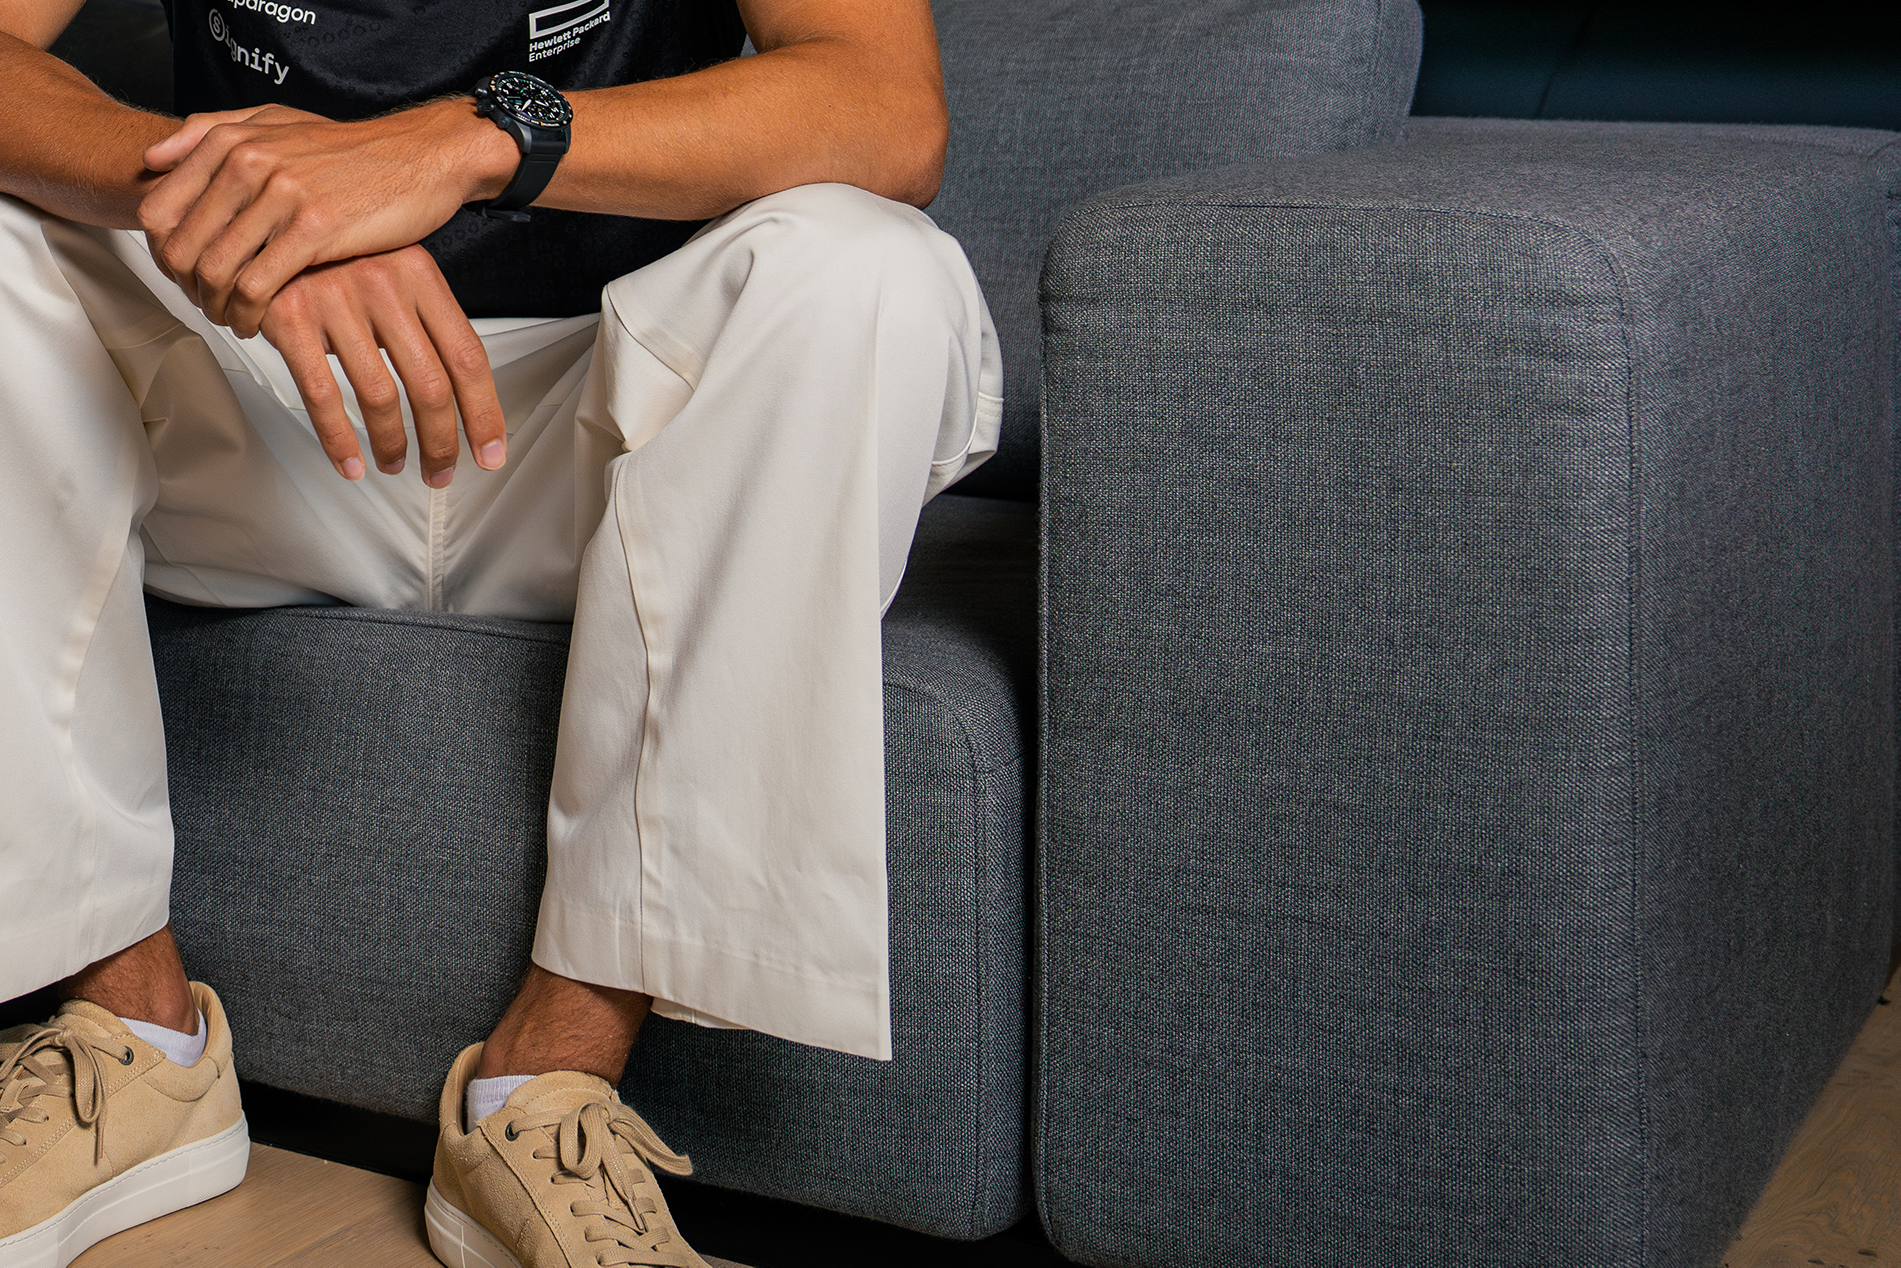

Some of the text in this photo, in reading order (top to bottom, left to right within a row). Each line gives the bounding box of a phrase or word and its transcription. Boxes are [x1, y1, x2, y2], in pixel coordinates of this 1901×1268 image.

[528, 35, 581, 62] Enterprise
[529, 10, 611, 53] Hewlett Packard
